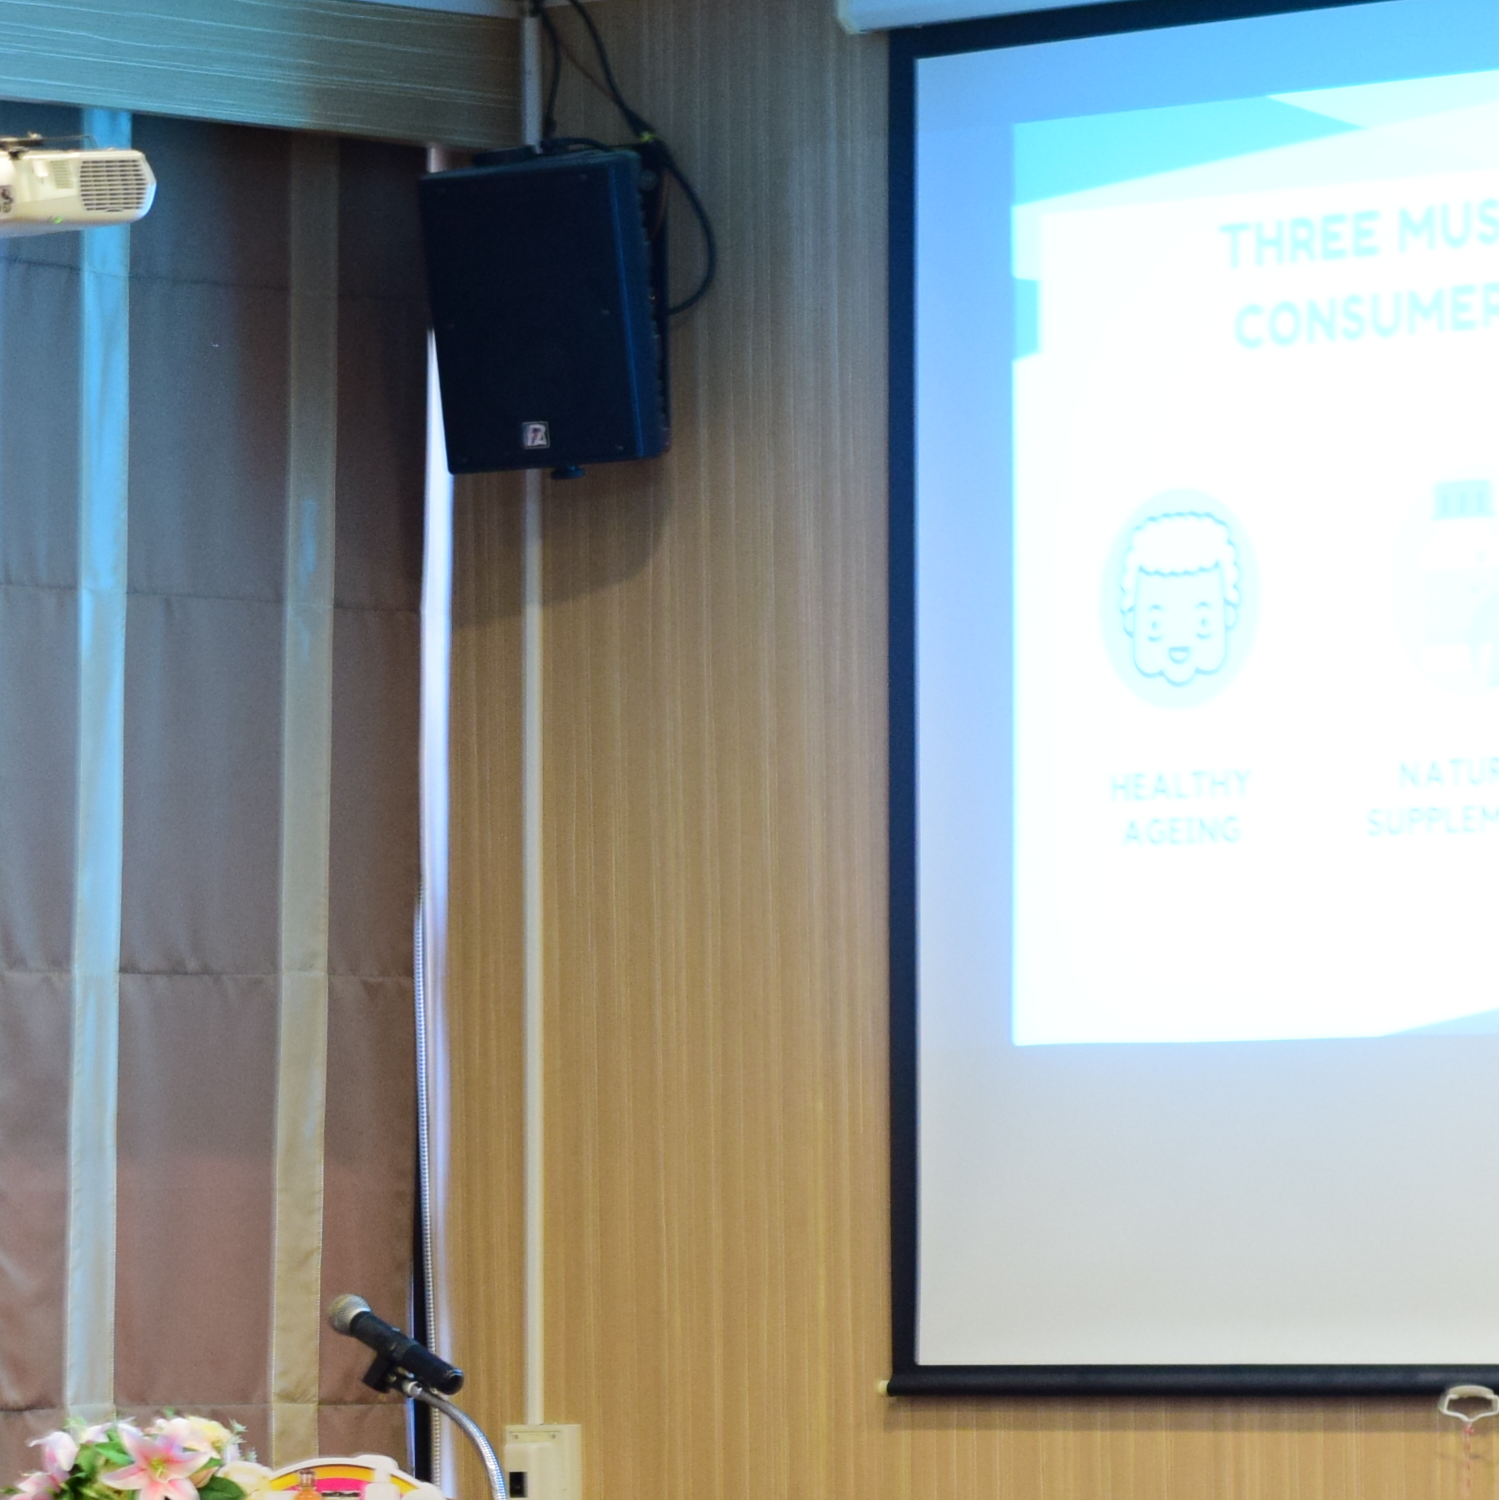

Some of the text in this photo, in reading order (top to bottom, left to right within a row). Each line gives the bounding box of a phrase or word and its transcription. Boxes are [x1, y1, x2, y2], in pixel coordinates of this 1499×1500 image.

[1218, 197, 1499, 270] THREE MUS
[1233, 281, 1499, 351] CONSUMER
[1109, 769, 1253, 803] HEALTHY
[1121, 814, 1243, 848] AGEING
